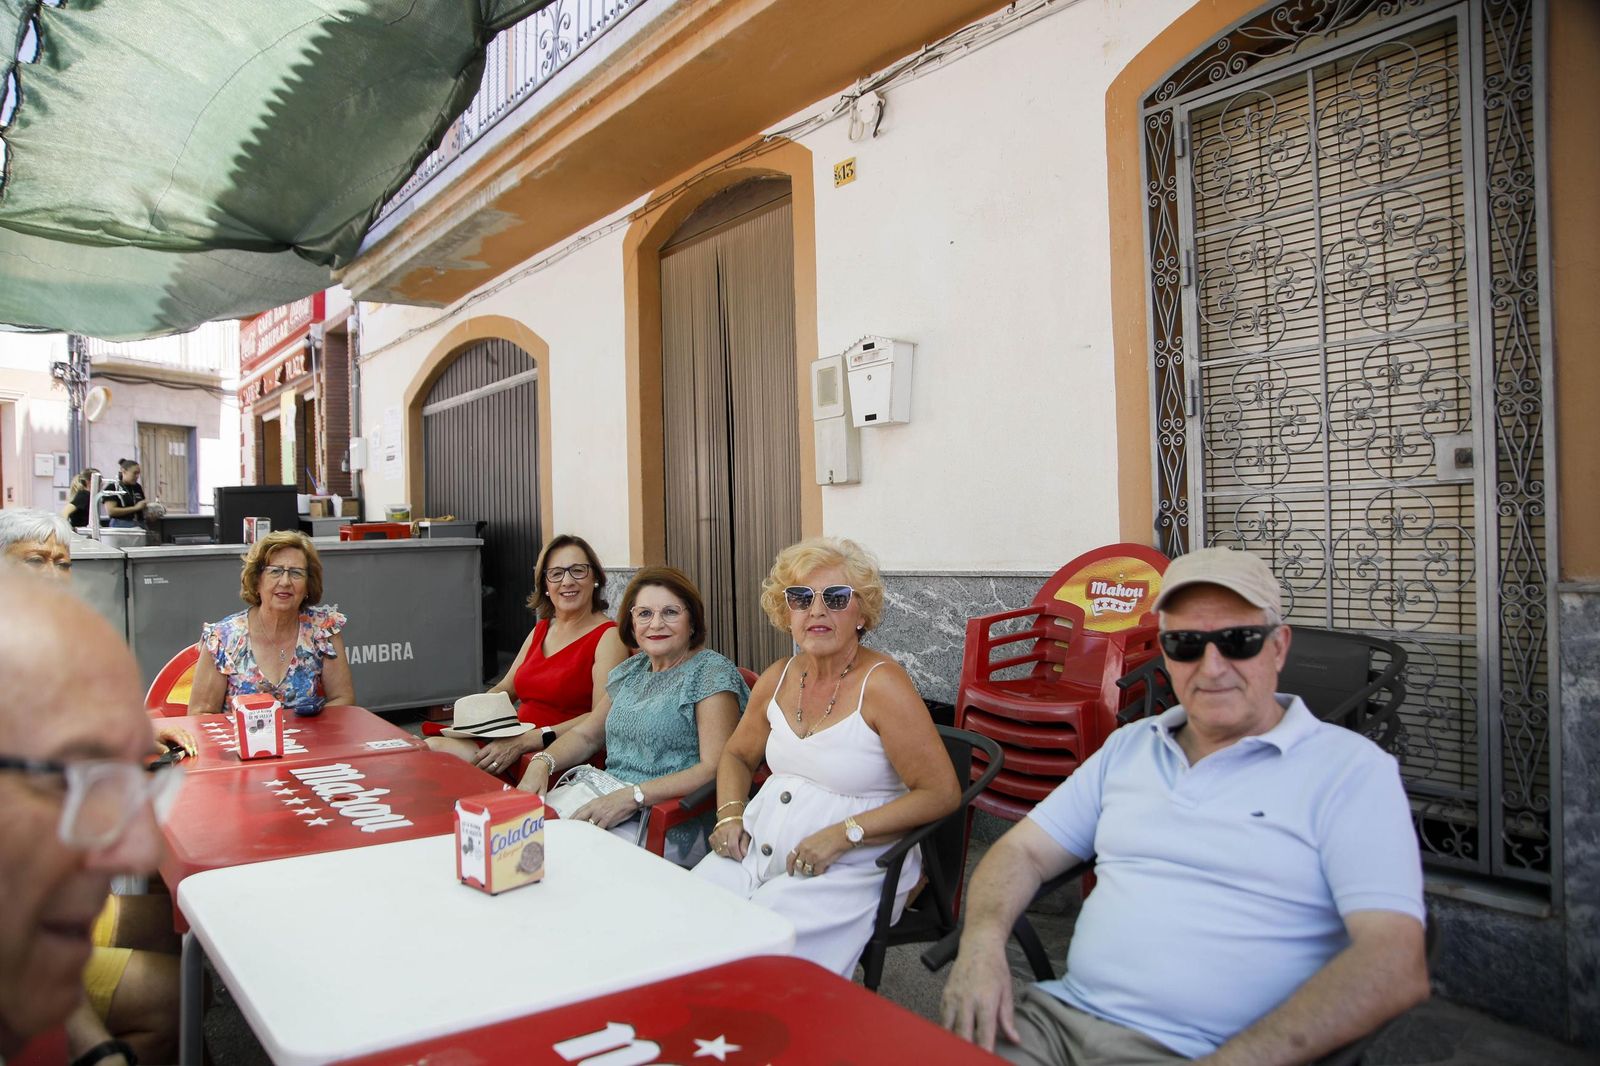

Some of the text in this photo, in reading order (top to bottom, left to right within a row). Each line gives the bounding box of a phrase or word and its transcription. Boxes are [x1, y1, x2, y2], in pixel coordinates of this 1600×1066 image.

[840, 161, 854, 180] 13
[1091, 581, 1144, 598] Mahou
[288, 763, 414, 833] Mahou
